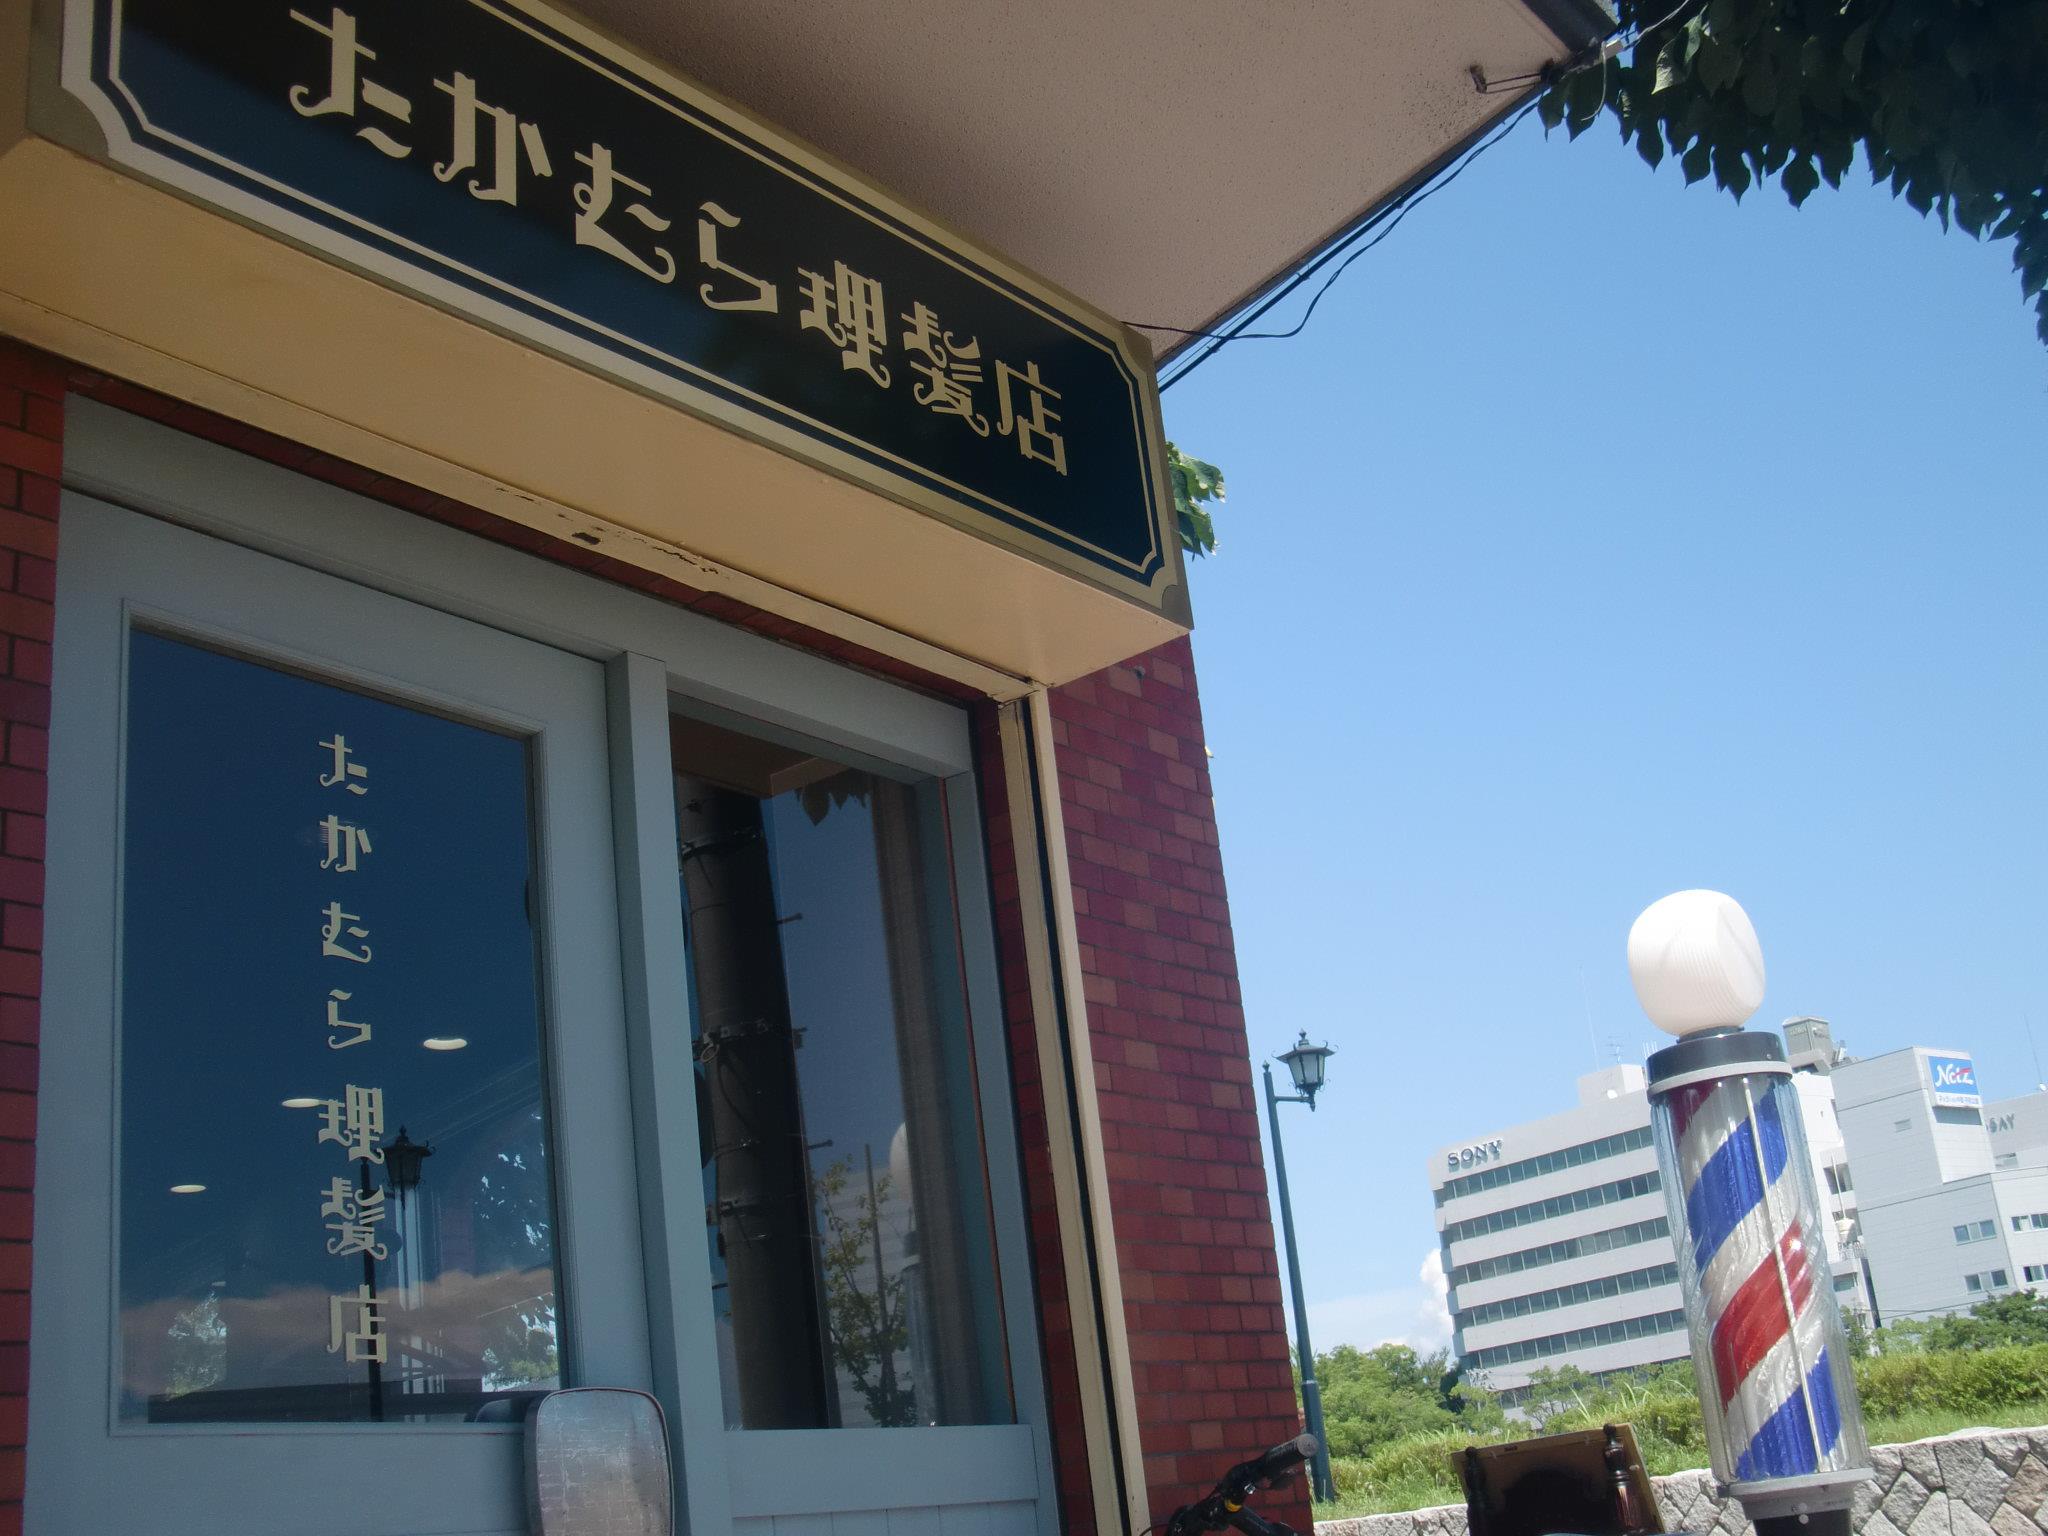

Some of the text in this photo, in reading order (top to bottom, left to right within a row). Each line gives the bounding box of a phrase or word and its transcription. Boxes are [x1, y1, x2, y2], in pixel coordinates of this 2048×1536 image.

[289, 8, 1068, 476] たかむら理髪店
[318, 733, 389, 1365] たかむら理髪店
[1448, 1139, 1503, 1166] SONY
